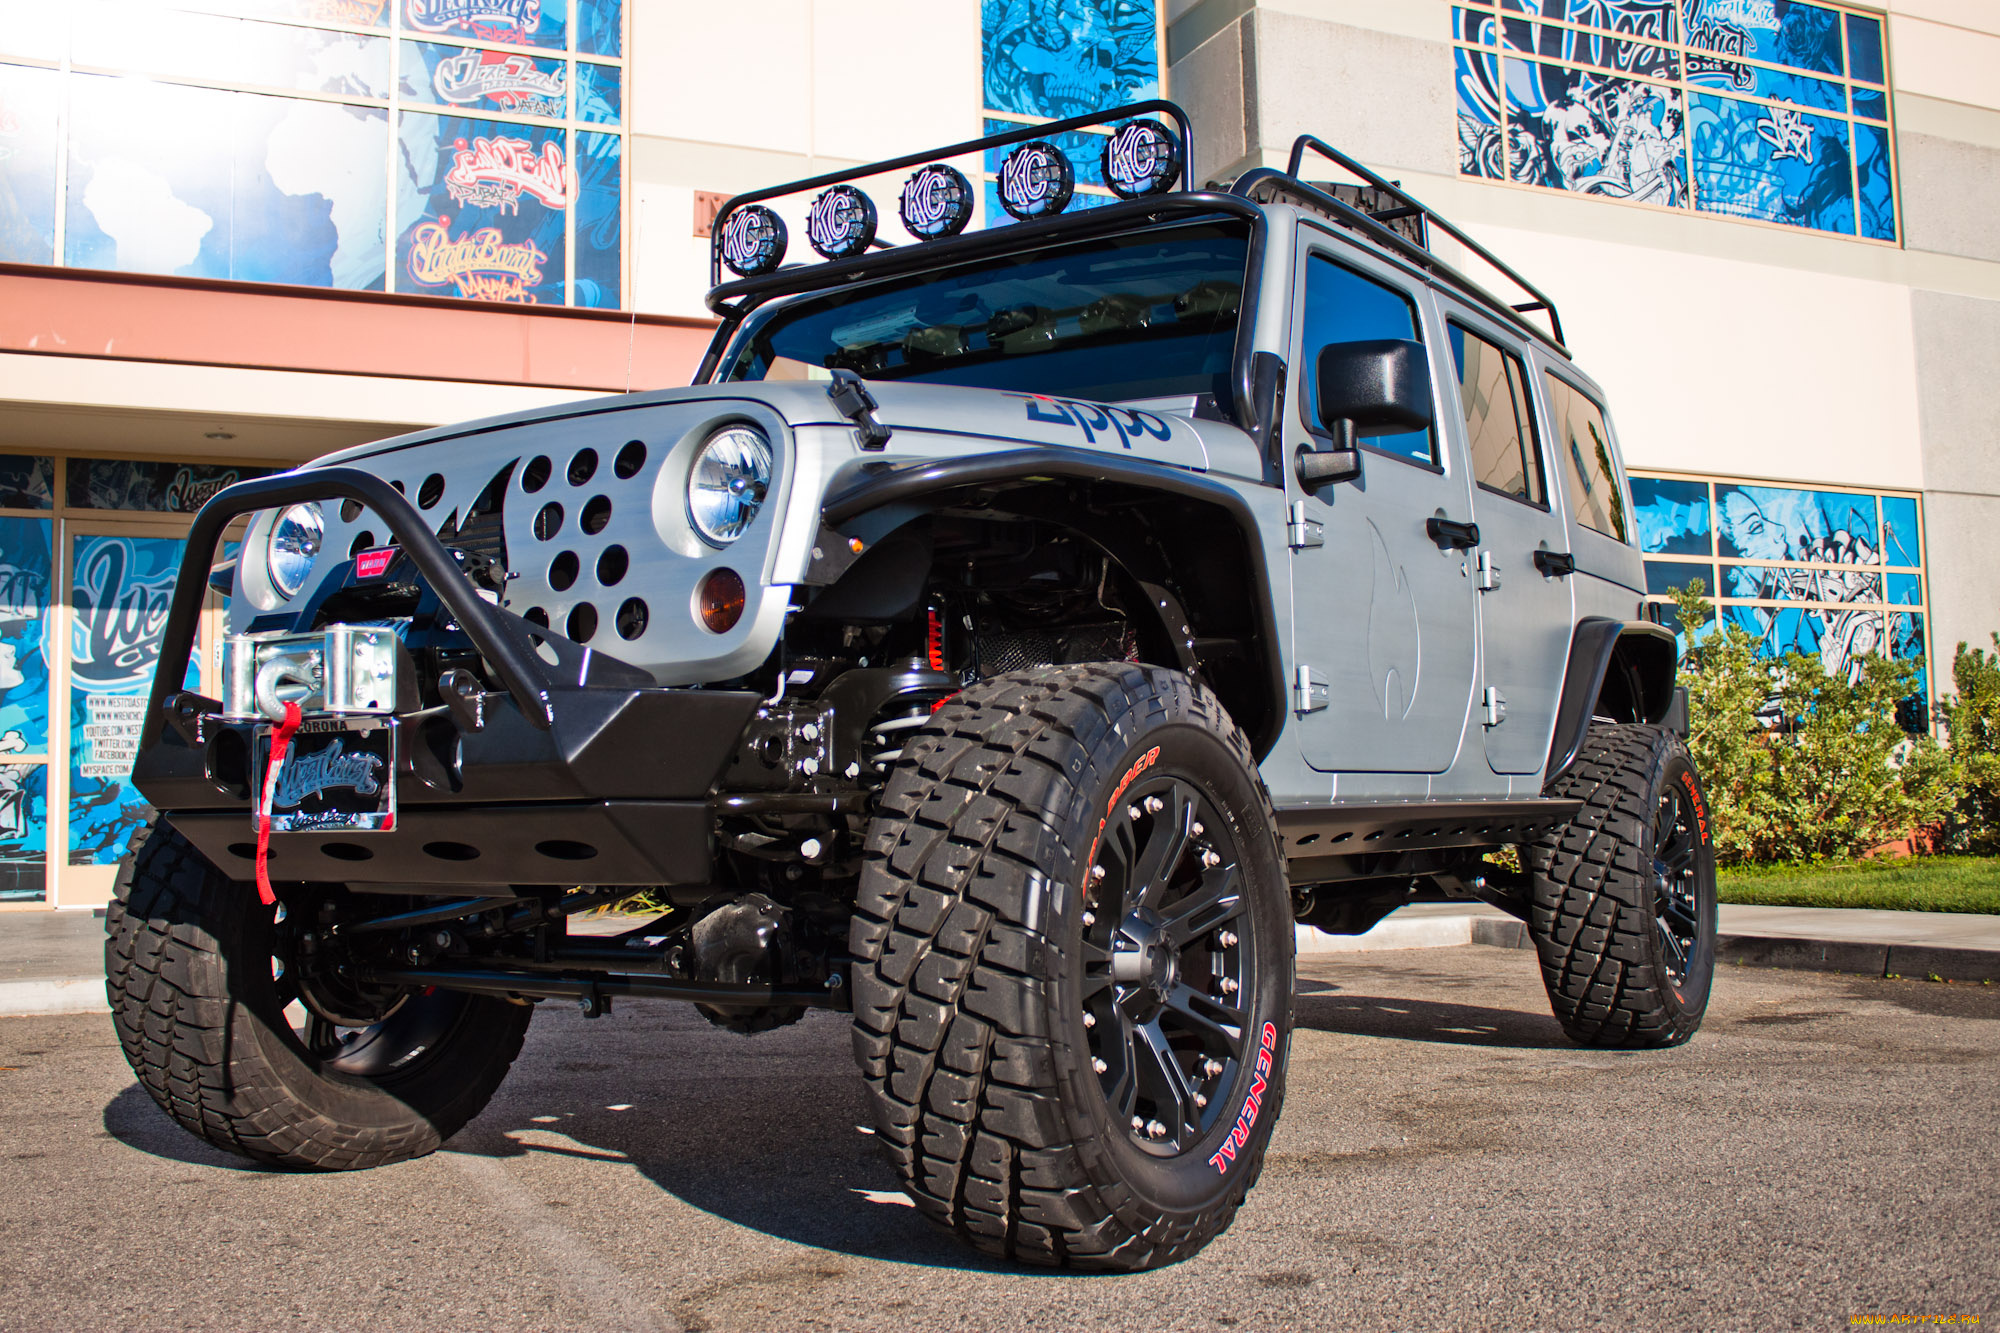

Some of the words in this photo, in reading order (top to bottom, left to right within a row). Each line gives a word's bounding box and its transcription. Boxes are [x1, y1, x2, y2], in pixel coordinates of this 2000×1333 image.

[1003, 148, 1048, 206] KC
[1109, 125, 1155, 184] KC
[811, 191, 850, 245] KC
[905, 166, 947, 226] KC
[724, 211, 760, 262] KC
[360, 557, 386, 570] WARN
[299, 721, 348, 734] CORONA
[1681, 770, 1708, 846] GENERAL
[1208, 1021, 1277, 1175] GENERAL
